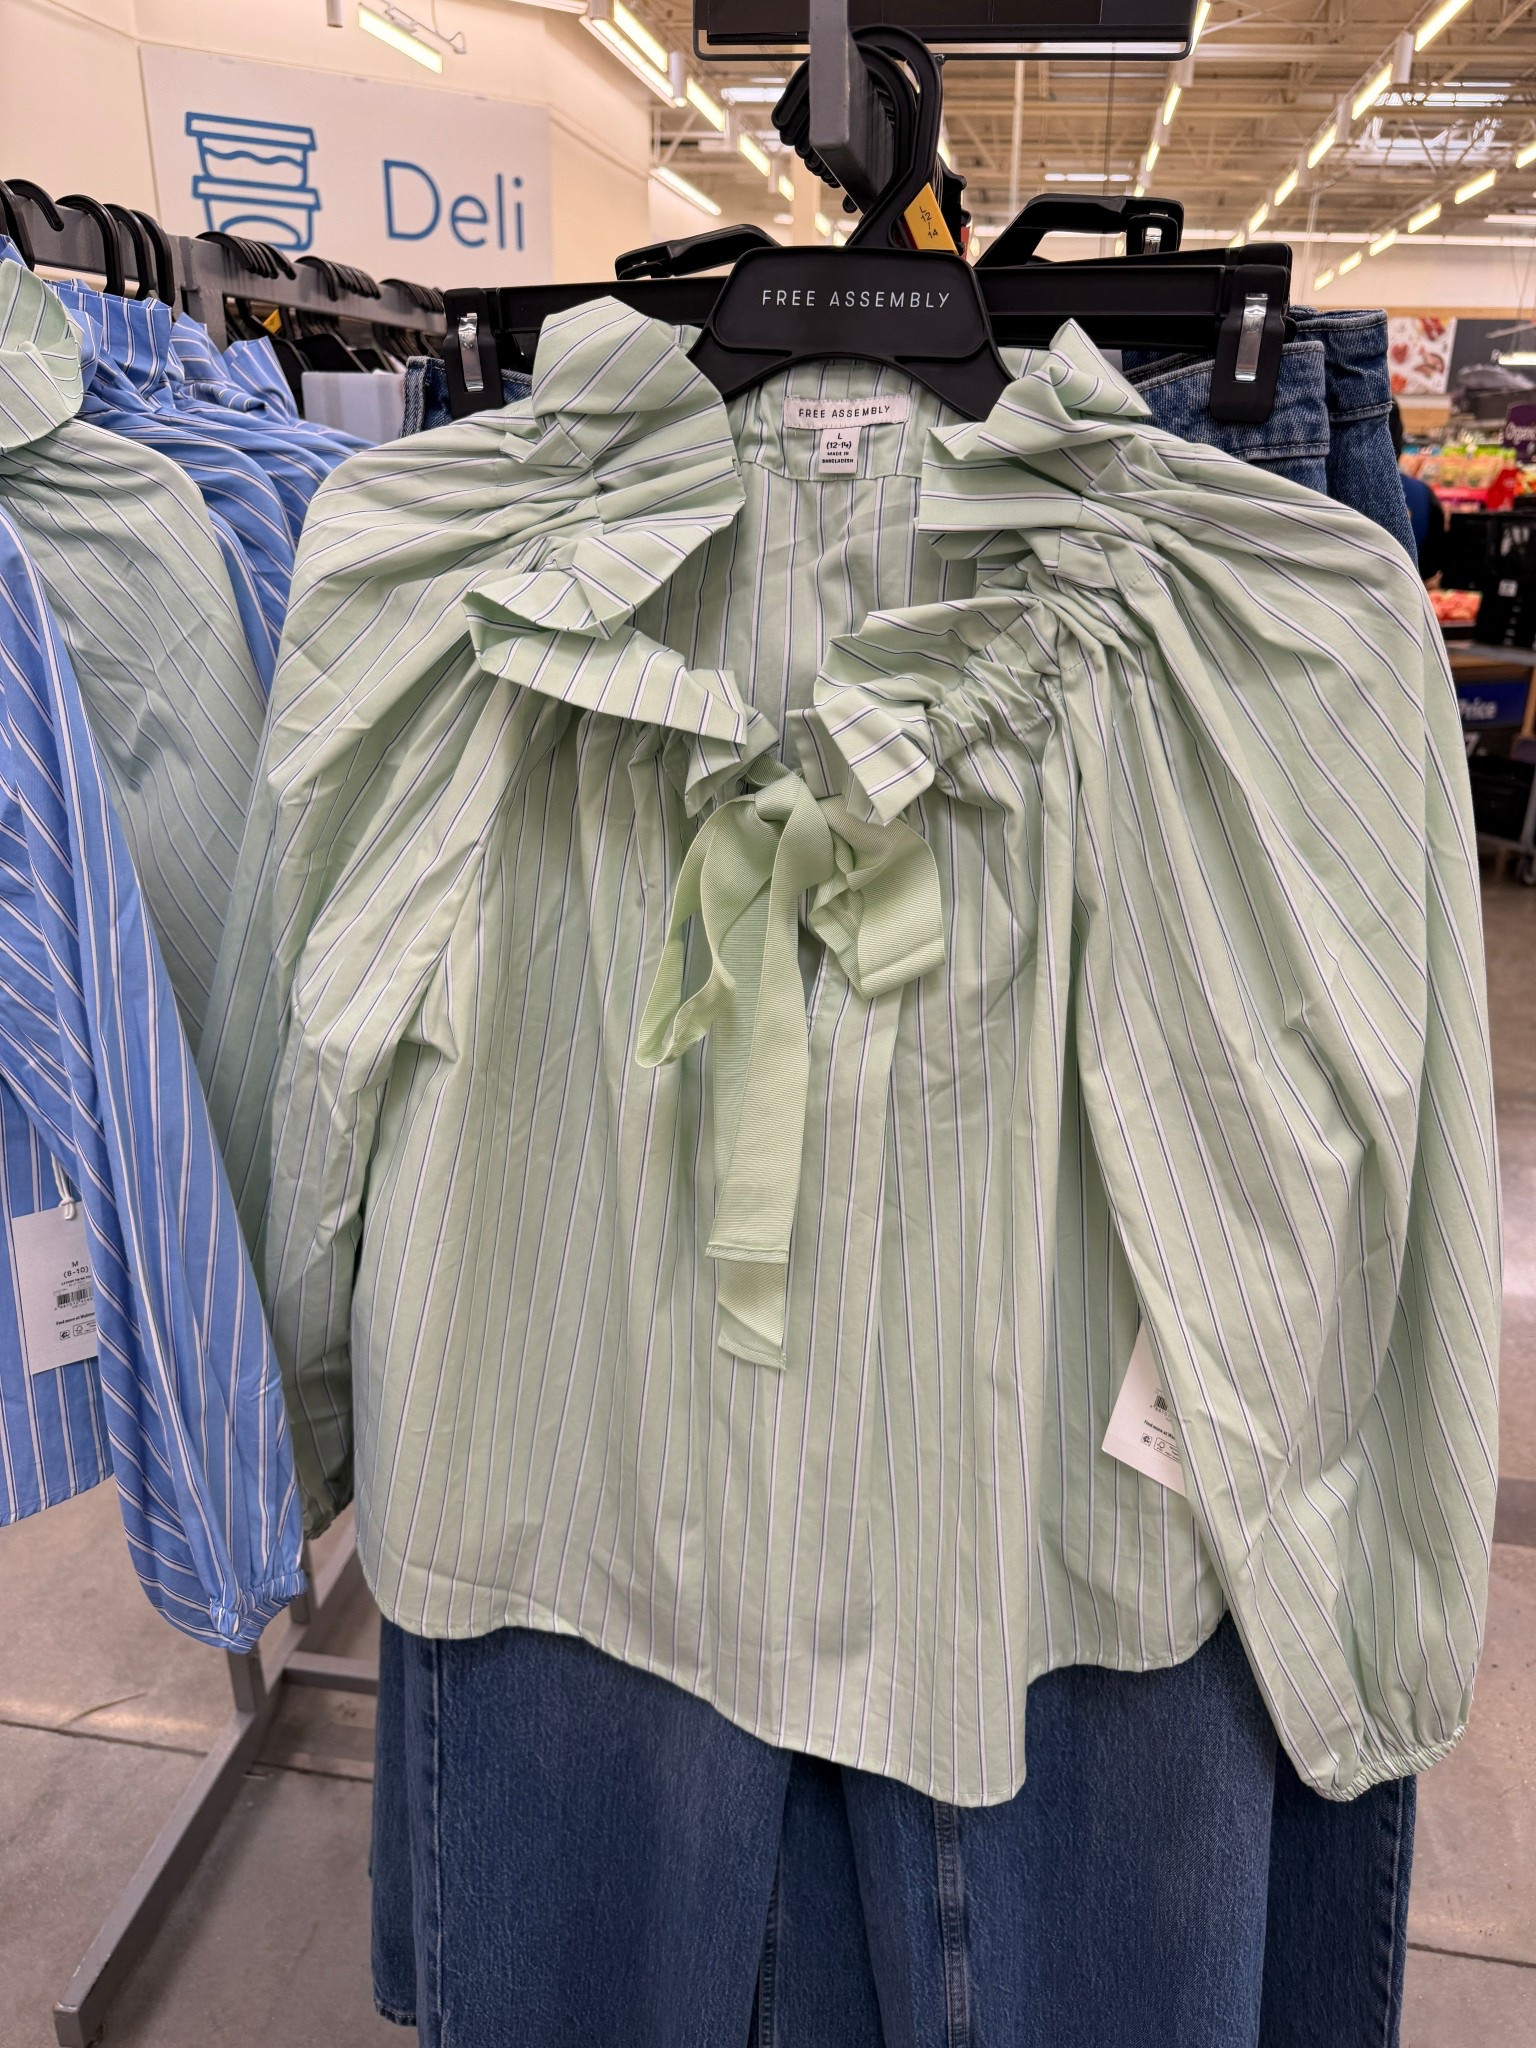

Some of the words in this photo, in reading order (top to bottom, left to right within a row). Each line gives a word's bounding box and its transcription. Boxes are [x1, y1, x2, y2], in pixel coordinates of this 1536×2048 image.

[383, 159, 524, 250] Deli
[919, 205, 926, 213] L
[920, 212, 931, 222] 12
[928, 229, 938, 239] 14
[762, 290, 816, 306] FREE
[829, 291, 949, 308] ASSEMBLY
[798, 408, 826, 419] FREE
[832, 405, 890, 418] ASSEMBLY
[837, 432, 843, 440] L
[826, 441, 852, 450] (12-14)
[72, 1260, 79, 1268] M
[63, 1265, 89, 1278] (8-10)
